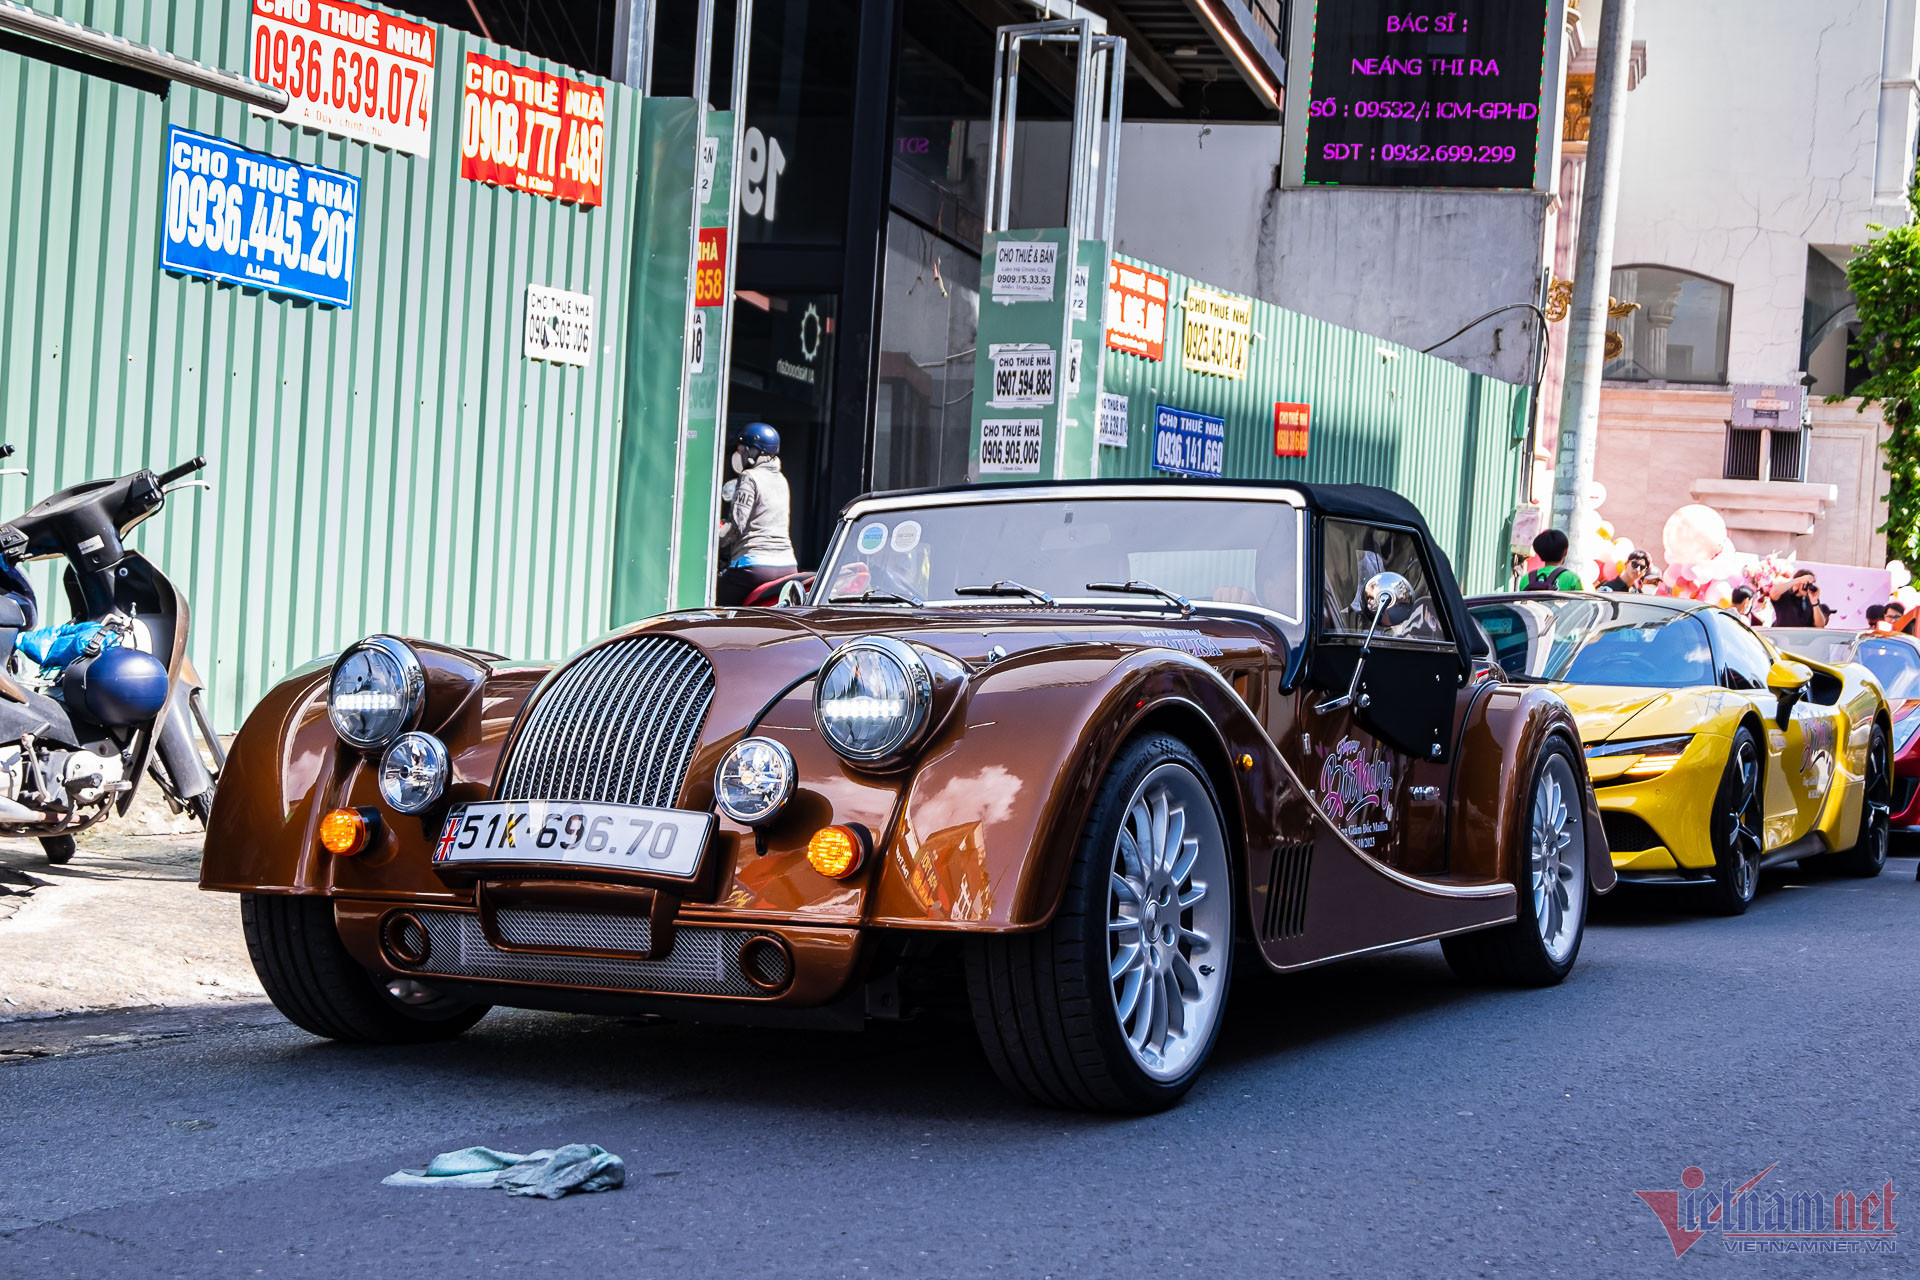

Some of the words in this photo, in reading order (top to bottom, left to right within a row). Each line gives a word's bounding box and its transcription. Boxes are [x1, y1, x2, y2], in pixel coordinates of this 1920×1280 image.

[318, 3, 380, 46] THUÊ
[386, 24, 432, 63] NHÀ
[1386, 13, 1429, 33] BÁC
[254, 24, 428, 132] 0936.639.074
[1351, 55, 1422, 76] NEÁNG
[1469, 59, 1500, 77] RA
[1323, 143, 1363, 161] SDT
[1381, 144, 1516, 163] 0932.699.299
[173, 141, 229, 179] CHO
[235, 156, 301, 199] THUÊ
[306, 177, 354, 214] NHÀ
[168, 170, 354, 283] 0936.445.201
[999, 247, 1014, 263] CHO
[1015, 244, 1034, 263] THUÊ
[1039, 244, 1055, 264] BÁN
[1188, 296, 1207, 314] CHO
[999, 357, 1014, 367] CHO
[1016, 353, 1035, 367] THUÊ
[996, 368, 1052, 396] 0907.594.883
[983, 424, 1000, 438] CHO
[1001, 420, 1022, 437] THUÊ
[1023, 420, 1041, 437] NHÀ
[1159, 412, 1178, 429] CHO
[1180, 416, 1204, 434] THUÊ
[1205, 422, 1224, 438] NHÀ
[981, 439, 1040, 465] 0906.905.006
[457, 812, 679, 860] 51K-696.70
